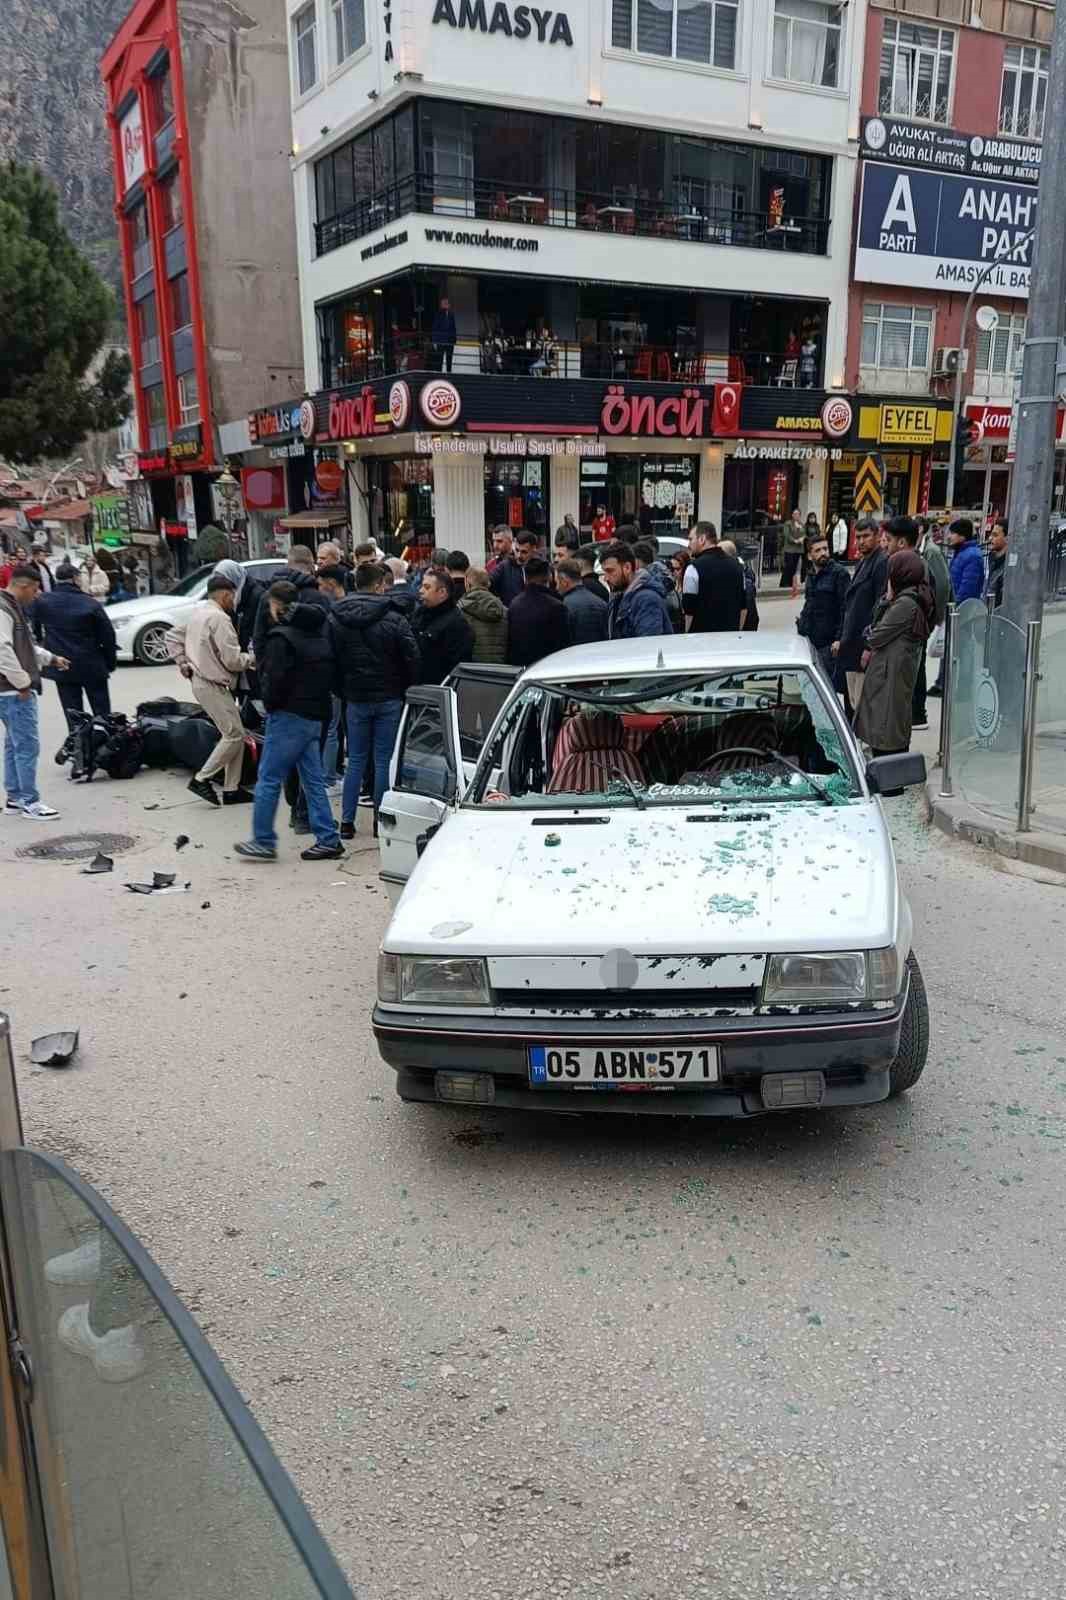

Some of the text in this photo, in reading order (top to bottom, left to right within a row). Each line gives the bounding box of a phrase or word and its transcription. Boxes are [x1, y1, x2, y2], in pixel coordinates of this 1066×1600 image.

[432, 0, 574, 47] AMASYA
[889, 125, 937, 143] AVUKAT
[888, 141, 916, 161] UĞUR
[917, 146, 934, 162] ALİ
[934, 150, 966, 170] AKTAŞ
[984, 140, 1043, 163] ARABULUCU
[880, 173, 918, 234] A
[957, 186, 1038, 228] ANAH
[424, 227, 540, 252] www.oncudoner.com
[878, 231, 918, 253] PARTİ
[981, 226, 1035, 263] PAR
[936, 263, 993, 286] AMASYA
[996, 266, 1007, 287] İL
[775, 416, 823, 430] AMASYA
[884, 408, 933, 431] EYFEL
[980, 407, 1012, 429] kom
[759, 446, 793, 460] PAKET
[533, 1066, 546, 1076] TR
[547, 1050, 710, 1079] 05 ABN 571
